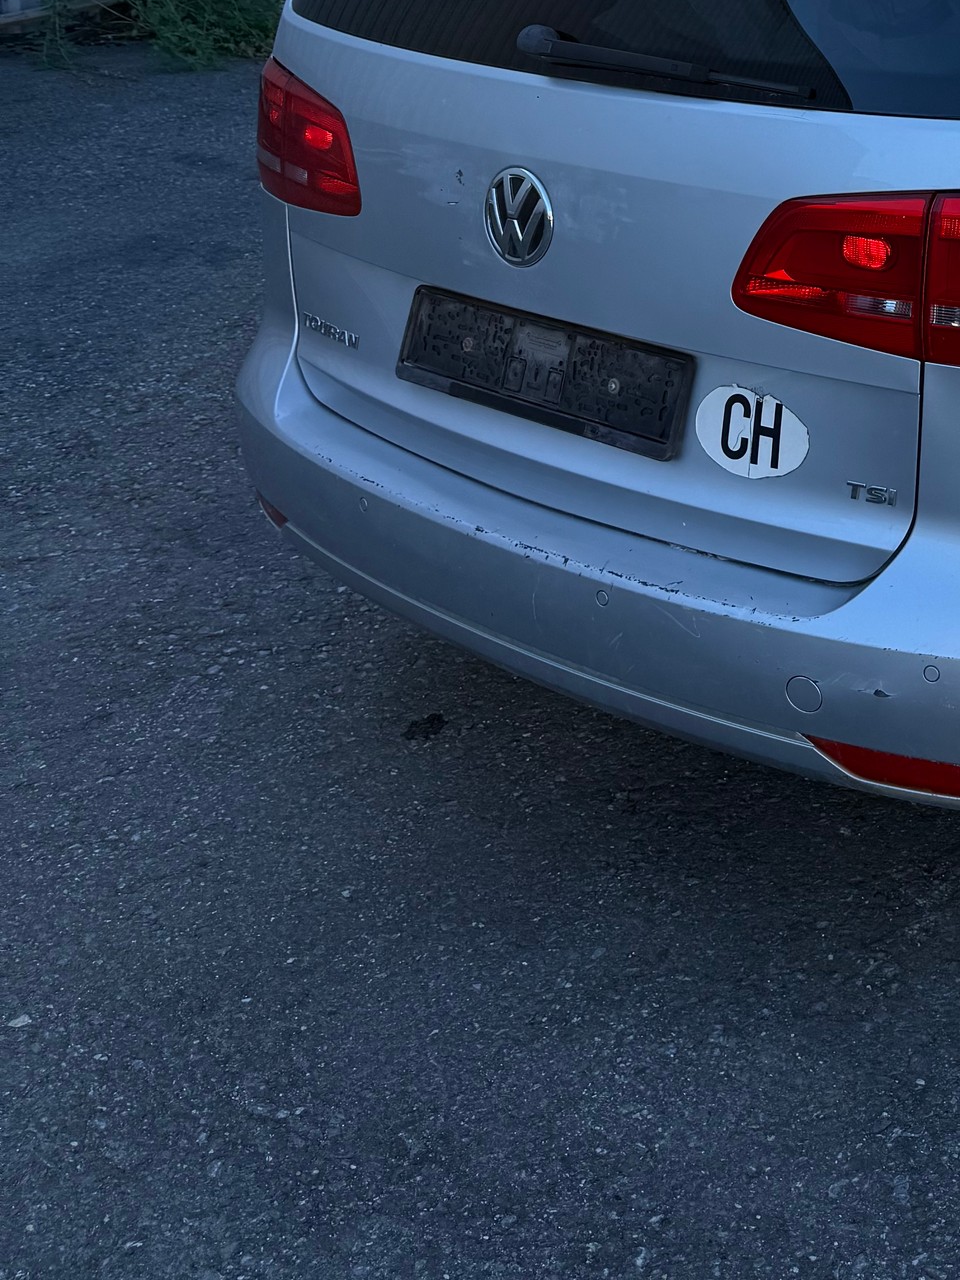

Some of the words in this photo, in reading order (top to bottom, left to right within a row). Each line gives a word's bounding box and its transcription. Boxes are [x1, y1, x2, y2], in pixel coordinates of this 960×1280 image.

[484, 167, 553, 268] VW
[720, 393, 783, 469] CH
[846, 480, 898, 506] TSI
